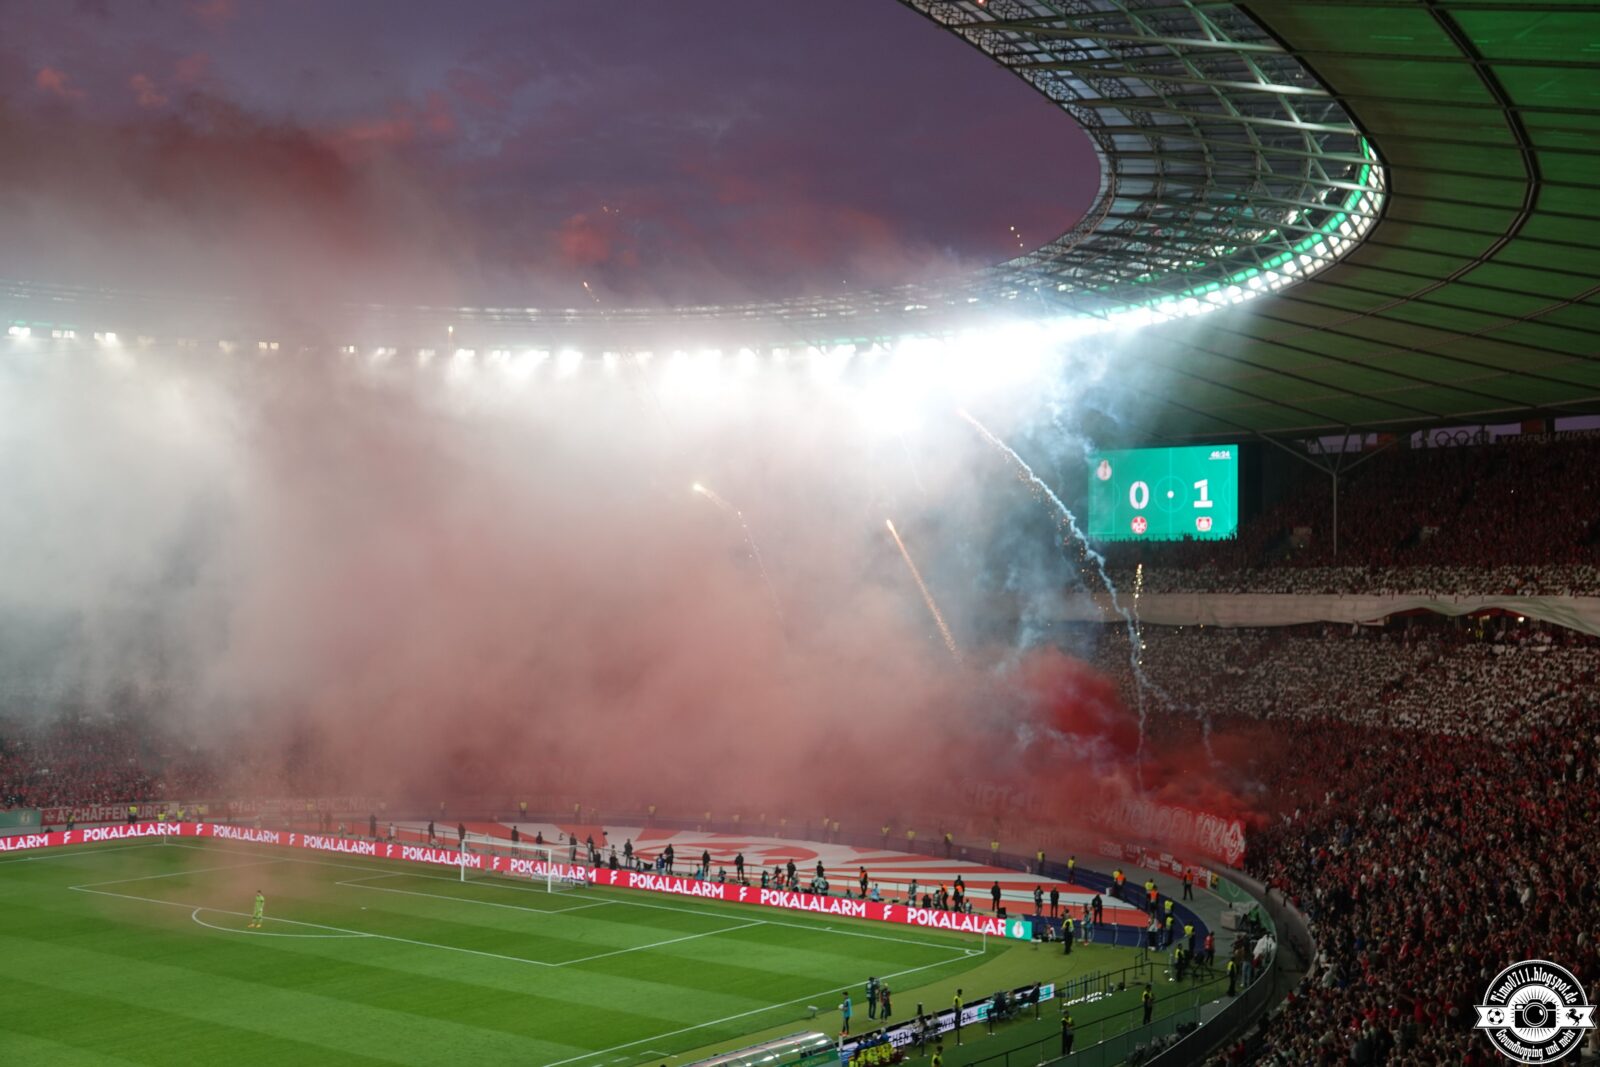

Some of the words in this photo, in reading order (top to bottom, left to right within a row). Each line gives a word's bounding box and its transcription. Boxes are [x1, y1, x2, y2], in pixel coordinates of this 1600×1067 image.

[1129, 481, 1149, 510] 0
[1193, 479, 1213, 508] 1
[83, 822, 181, 842] POKALALARM
[212, 824, 280, 844] POKALALARM
[303, 833, 376, 856] POKALALARM
[402, 844, 481, 869] POKALALARM
[629, 872, 724, 899] POKALALARM
[760, 888, 866, 918] POKALALARM
